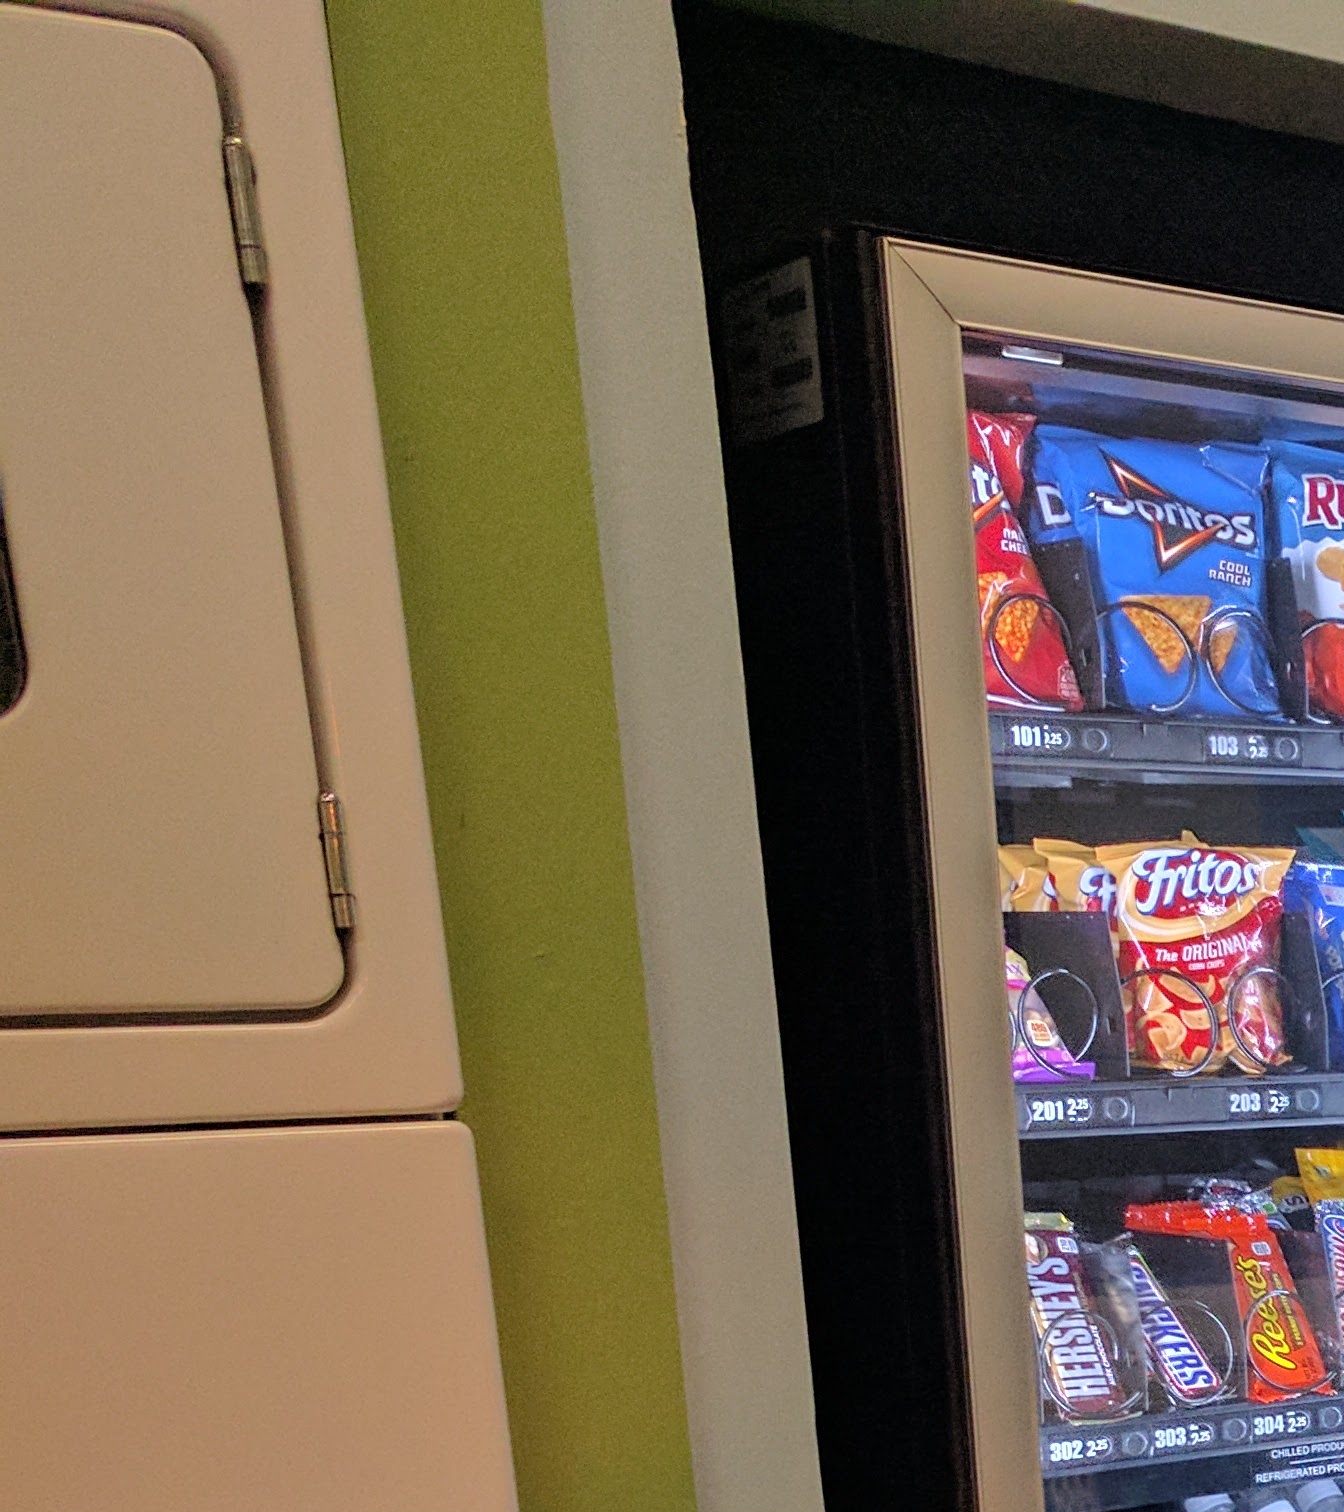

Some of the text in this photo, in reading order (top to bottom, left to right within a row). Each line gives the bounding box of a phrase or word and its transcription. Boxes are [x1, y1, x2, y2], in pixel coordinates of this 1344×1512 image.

[1097, 496, 1256, 545] Doritos
[1209, 569, 1252, 587] RANCH
[1219, 560, 1251, 576] COOL
[1012, 725, 1041, 747] 101
[1209, 735, 1238, 756] 103
[1132, 847, 1258, 915] Fritos
[1155, 948, 1178, 962] The
[1032, 1101, 1064, 1121] 201
[1230, 1093, 1261, 1112] 203
[1254, 1415, 1285, 1435] 304
[1155, 1429, 1186, 1449] 303
[1050, 1442, 1084, 1463] 302
[1271, 1445, 1309, 1459] CHILLED
[1255, 1465, 1326, 1484] REFRIGERATED
